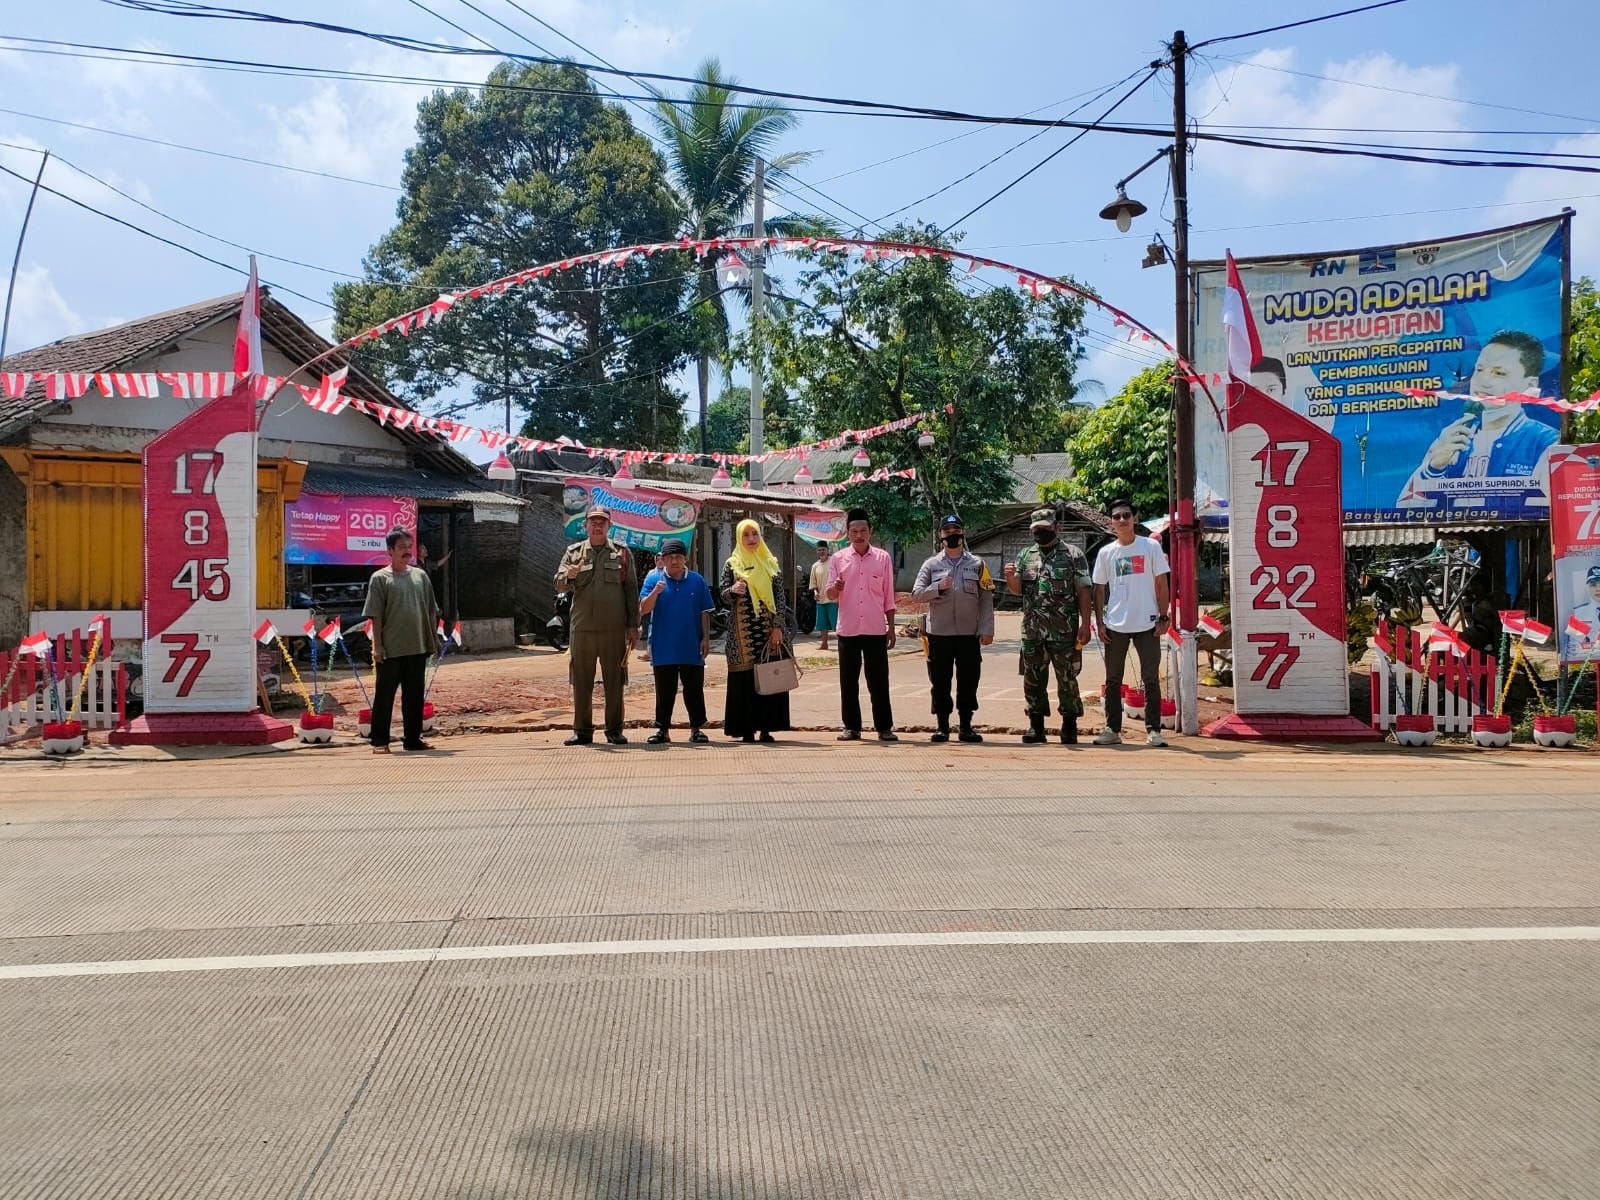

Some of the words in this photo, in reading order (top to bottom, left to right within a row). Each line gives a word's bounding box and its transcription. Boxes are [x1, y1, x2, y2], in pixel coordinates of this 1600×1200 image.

[1310, 259, 1346, 277] RN
[1264, 286, 1357, 324] MUDA
[1360, 270, 1490, 315] ADALAH
[1307, 307, 1443, 344] KEKUATAN
[1287, 345, 1368, 367] LANJUTKAN
[1370, 337, 1463, 358] PERCEPATAN
[1305, 385, 1344, 400] YANG
[1346, 376, 1442, 396] BERKUALITAS
[1319, 360, 1428, 381] PEMBANGUNAN
[1308, 402, 1338, 417] DAN
[1341, 394, 1439, 414] BERKEADILAN
[171, 449, 225, 496] 17
[1250, 440, 1310, 487] 17
[591, 486, 659, 517] Warmindo
[1456, 480, 1483, 489] ANDRI
[1485, 479, 1527, 488] SUPRIADI,
[1529, 479, 1541, 488] SH
[183, 510, 209, 545] 8
[291, 510, 314, 521] Tetap
[315, 512, 340, 523] Happy
[1267, 504, 1298, 548] 8
[1344, 511, 1401, 522] Bangun
[1406, 508, 1500, 520] Pandeglang
[171, 558, 231, 602] 45
[1250, 564, 1317, 610] 22
[160, 633, 211, 697] 77
[1247, 633, 1300, 689] 77
